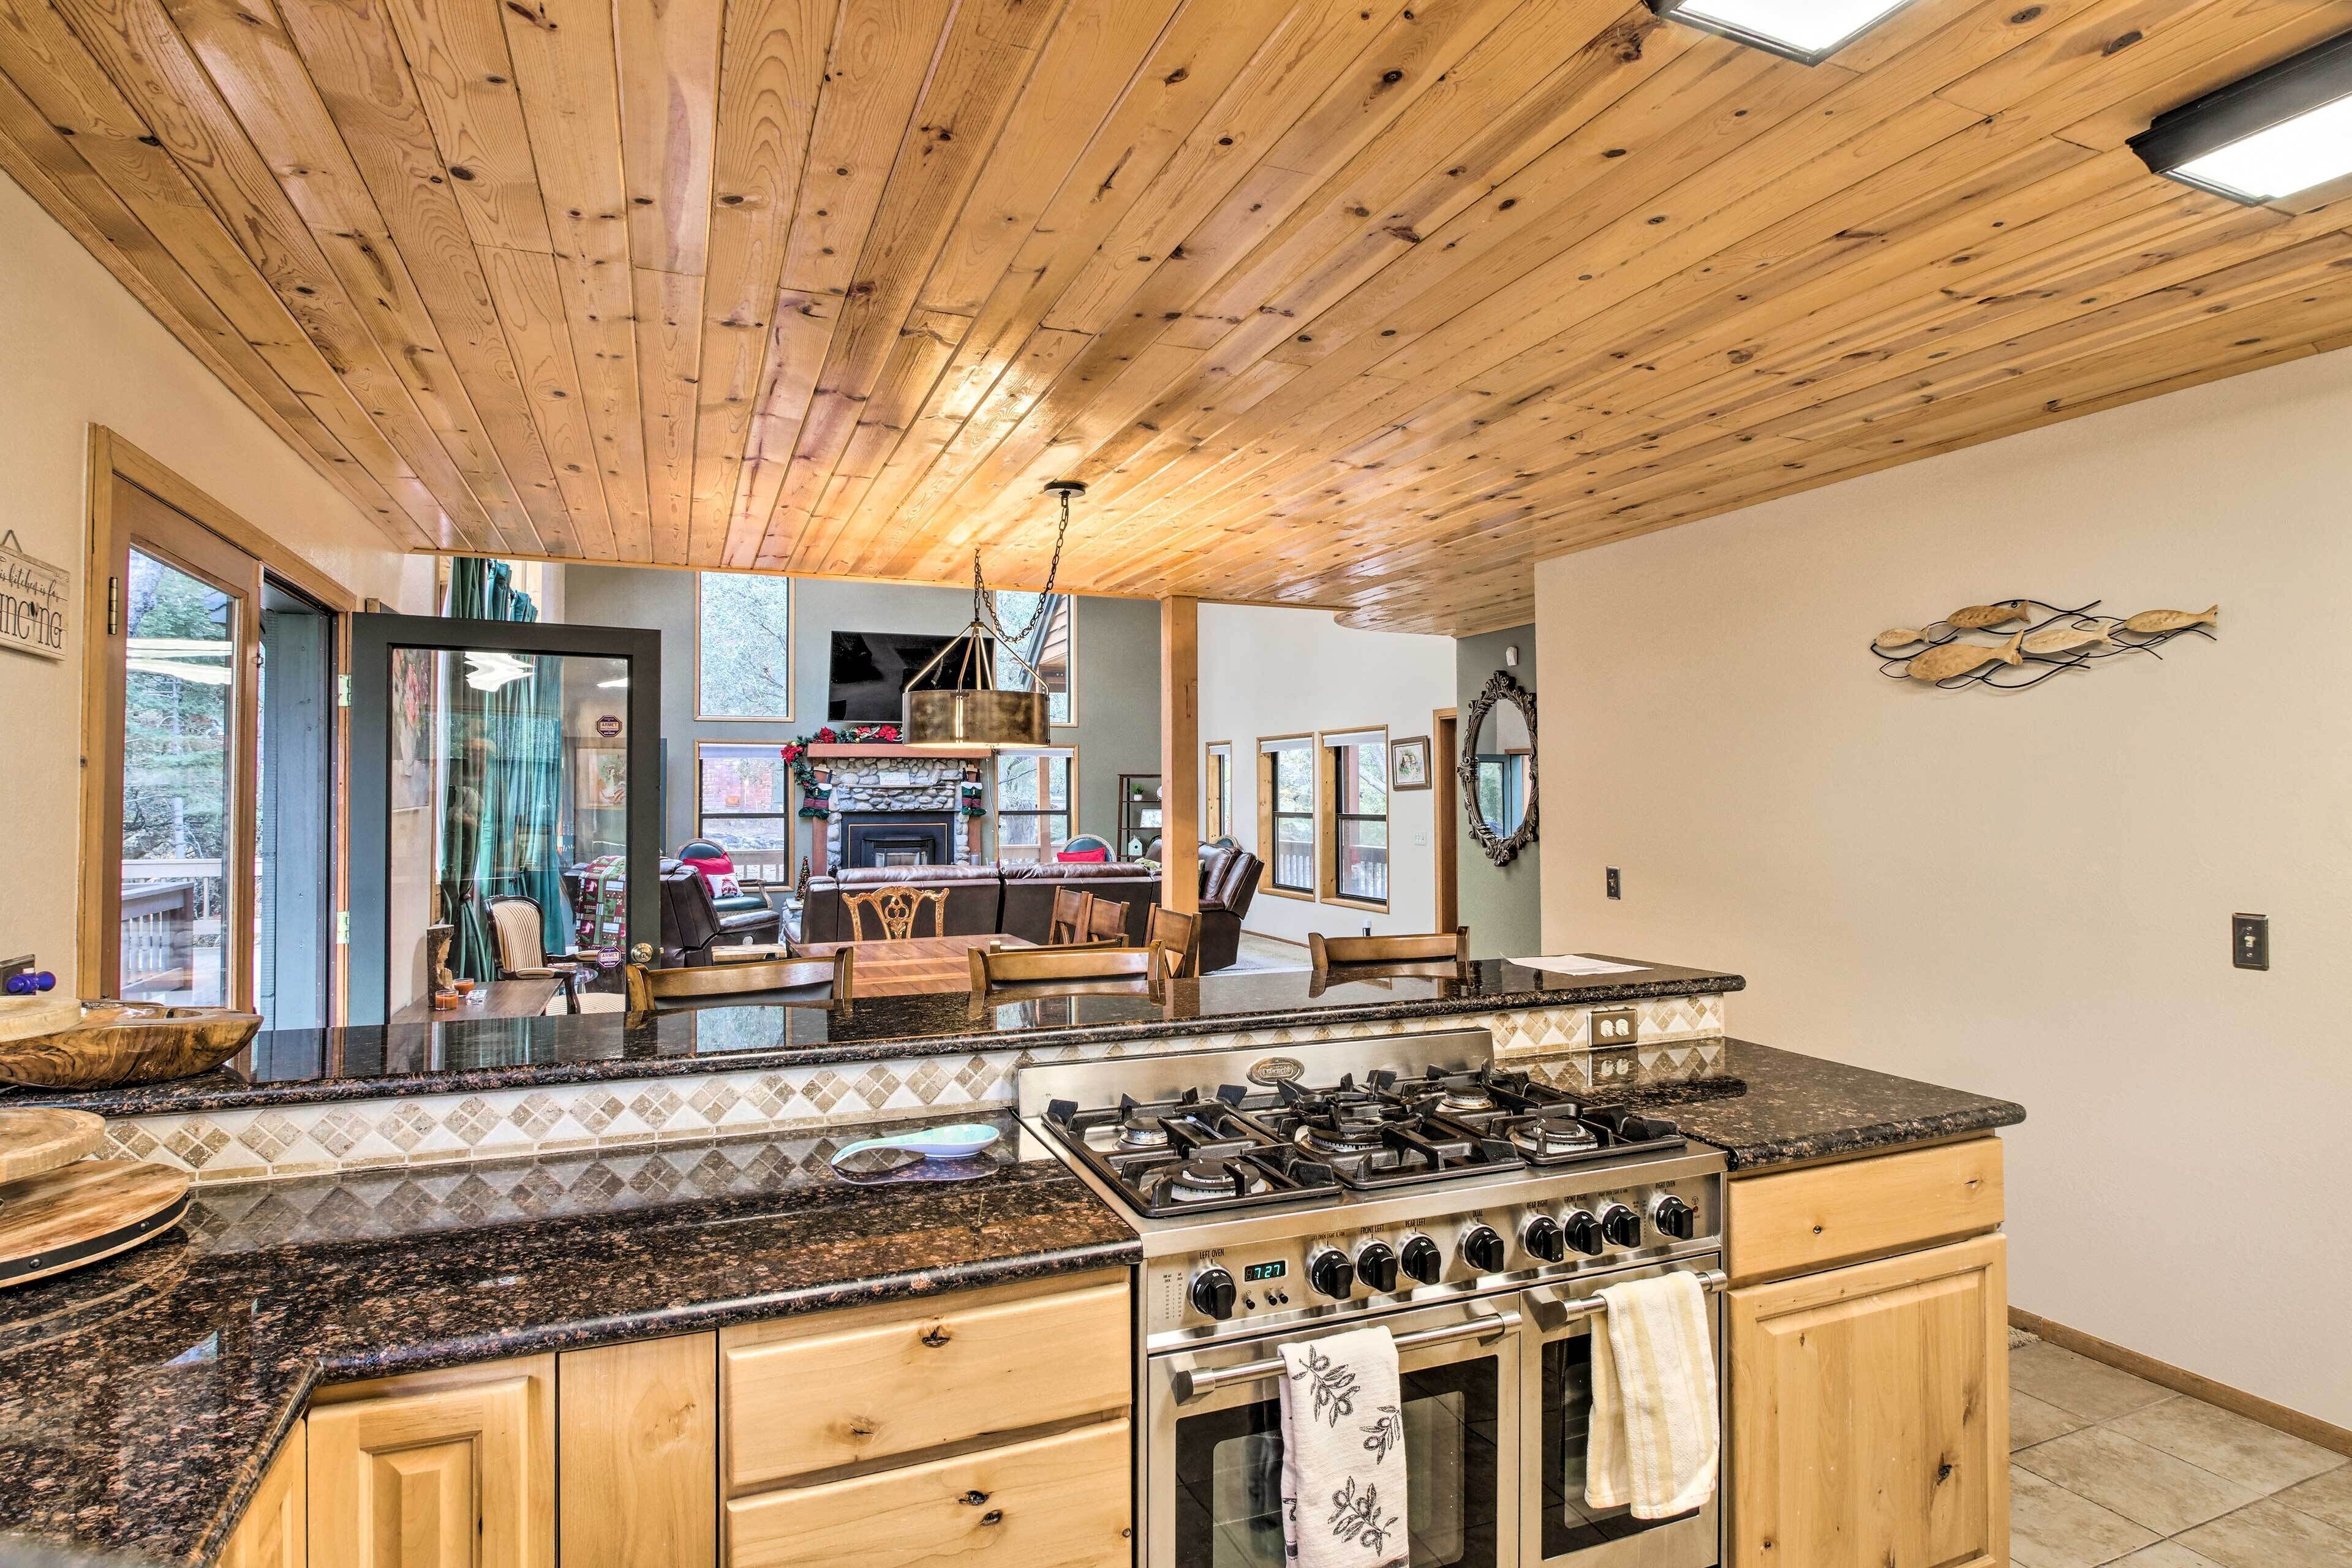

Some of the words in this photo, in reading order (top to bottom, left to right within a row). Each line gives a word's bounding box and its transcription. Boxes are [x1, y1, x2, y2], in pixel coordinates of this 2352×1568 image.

[40, 584, 45, 596] is
[1564, 1194, 1577, 1203] FRONT
[1537, 1199, 1548, 1208] RIGHT
[1472, 1208, 1483, 1217] DUAL
[1405, 1219, 1415, 1227] REAR
[1360, 1226, 1373, 1234] FRONT
[1374, 1224, 1384, 1232] LEFT
[1199, 1251, 1210, 1259] LEFT
[1212, 1248, 1224, 1257] OVEN
[1254, 1264, 1280, 1279] 727
